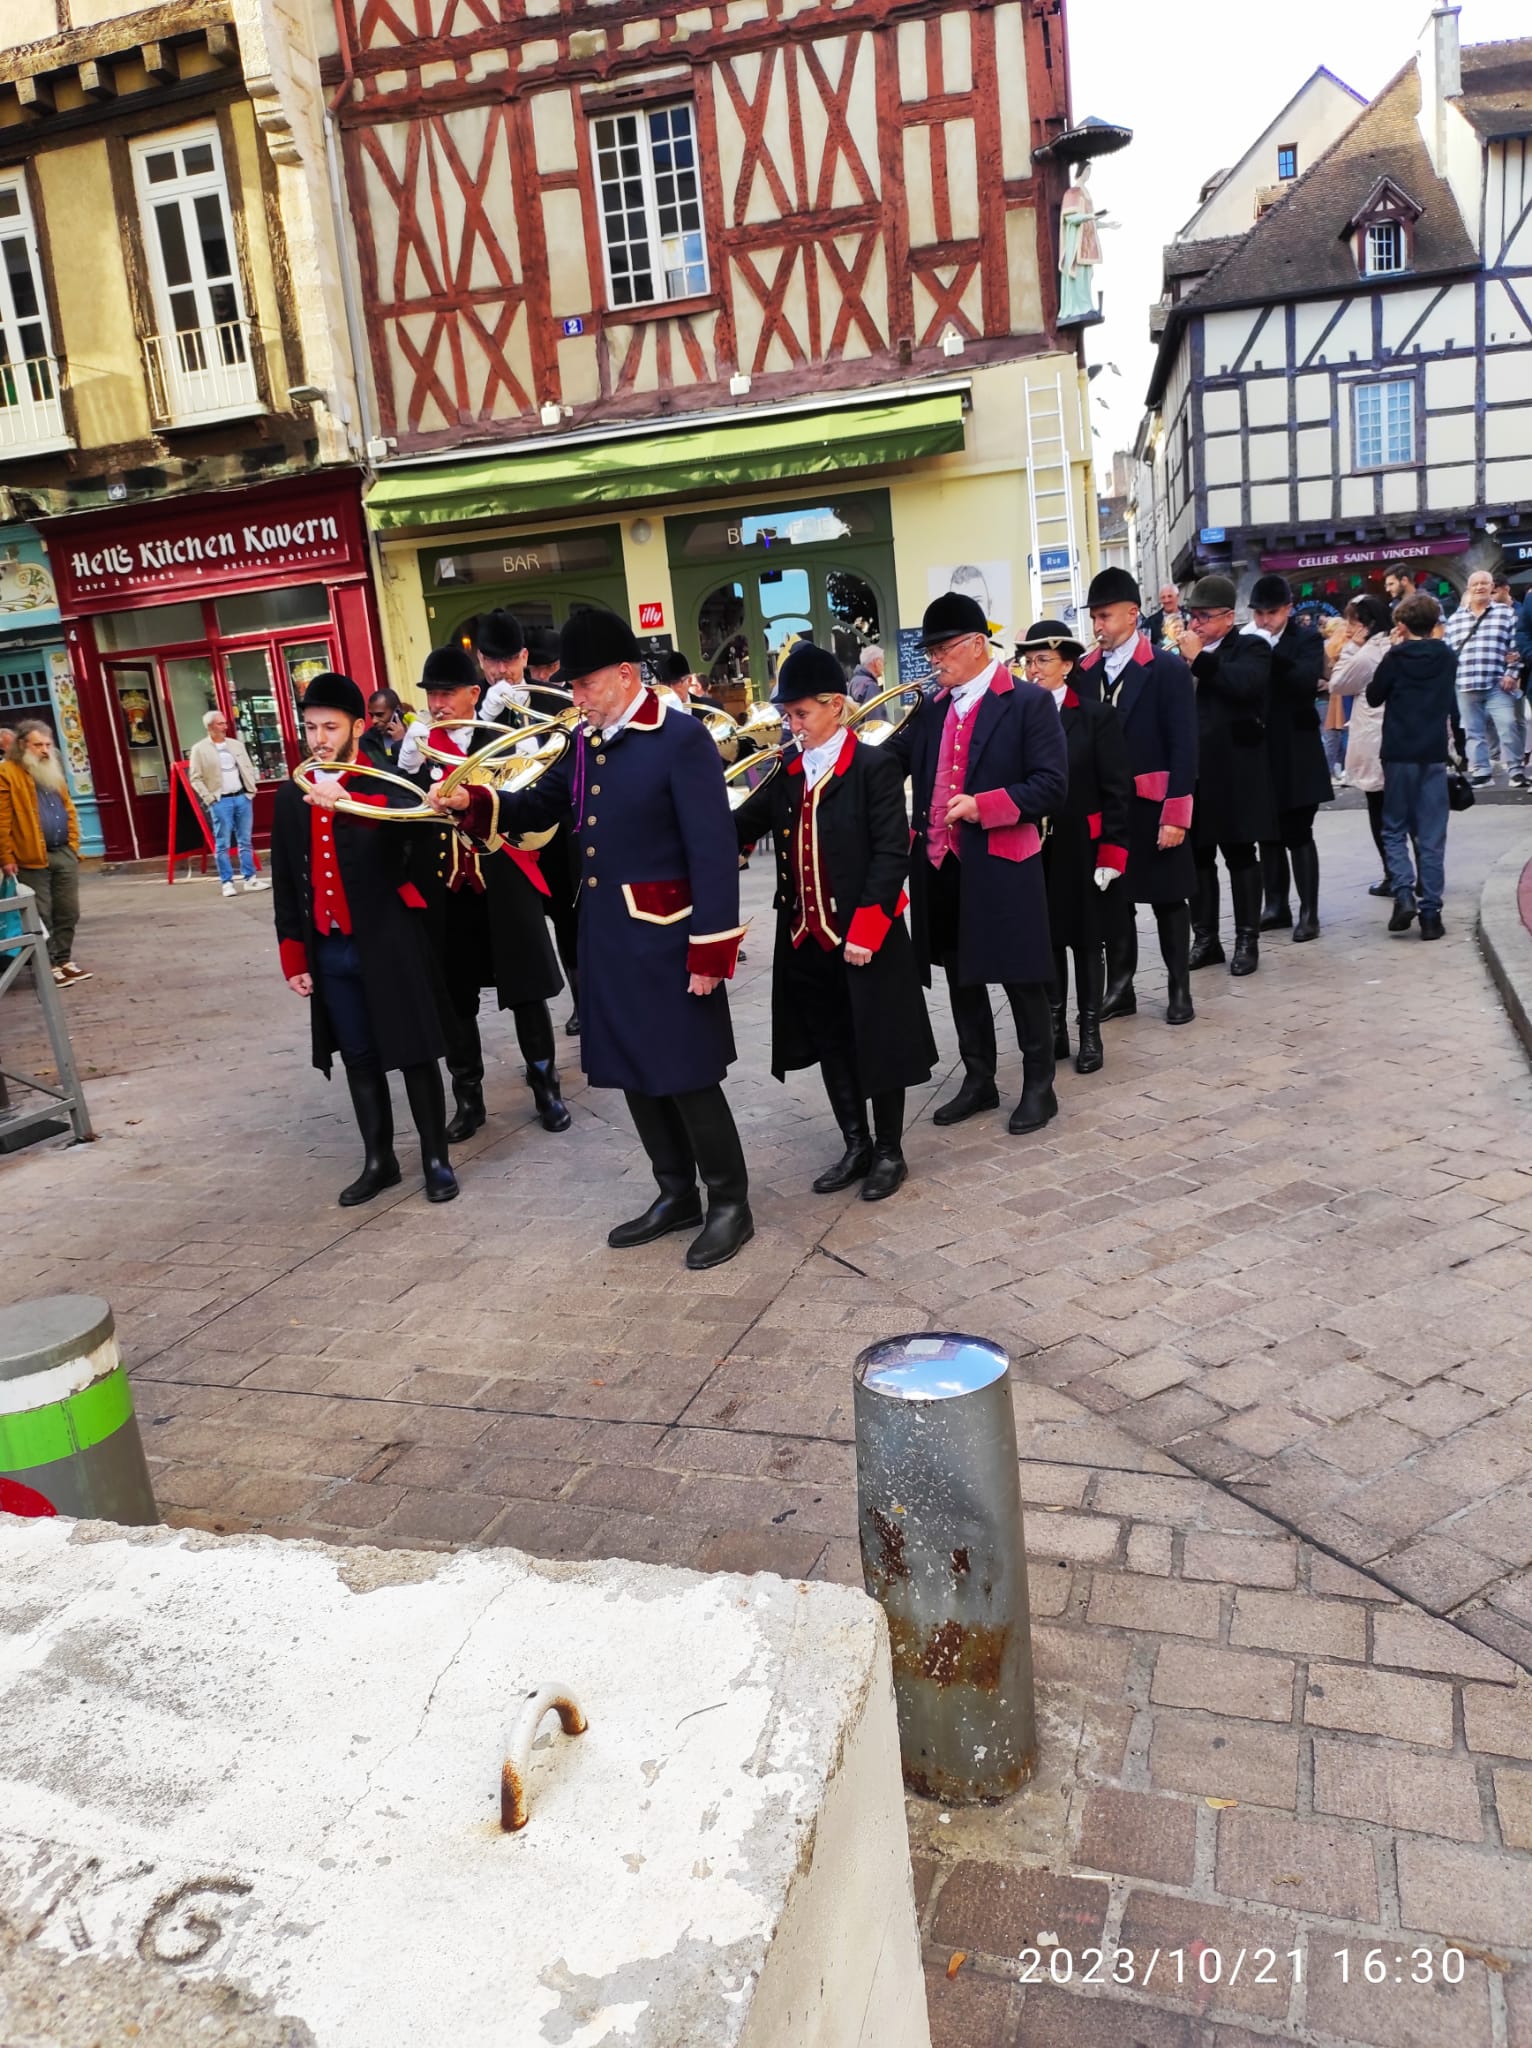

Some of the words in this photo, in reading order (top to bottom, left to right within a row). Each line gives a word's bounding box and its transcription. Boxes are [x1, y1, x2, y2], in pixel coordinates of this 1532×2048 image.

[71, 544, 134, 578] Hell's
[138, 532, 236, 569] Kitchen
[242, 516, 338, 553] Kavern
[1298, 555, 1339, 568] CELLIER
[1343, 551, 1376, 563] SAINT
[1382, 545, 1431, 559] VINCENT
[503, 553, 540, 573] BAR
[641, 606, 661, 625] illy
[69, 630, 77, 642] 4
